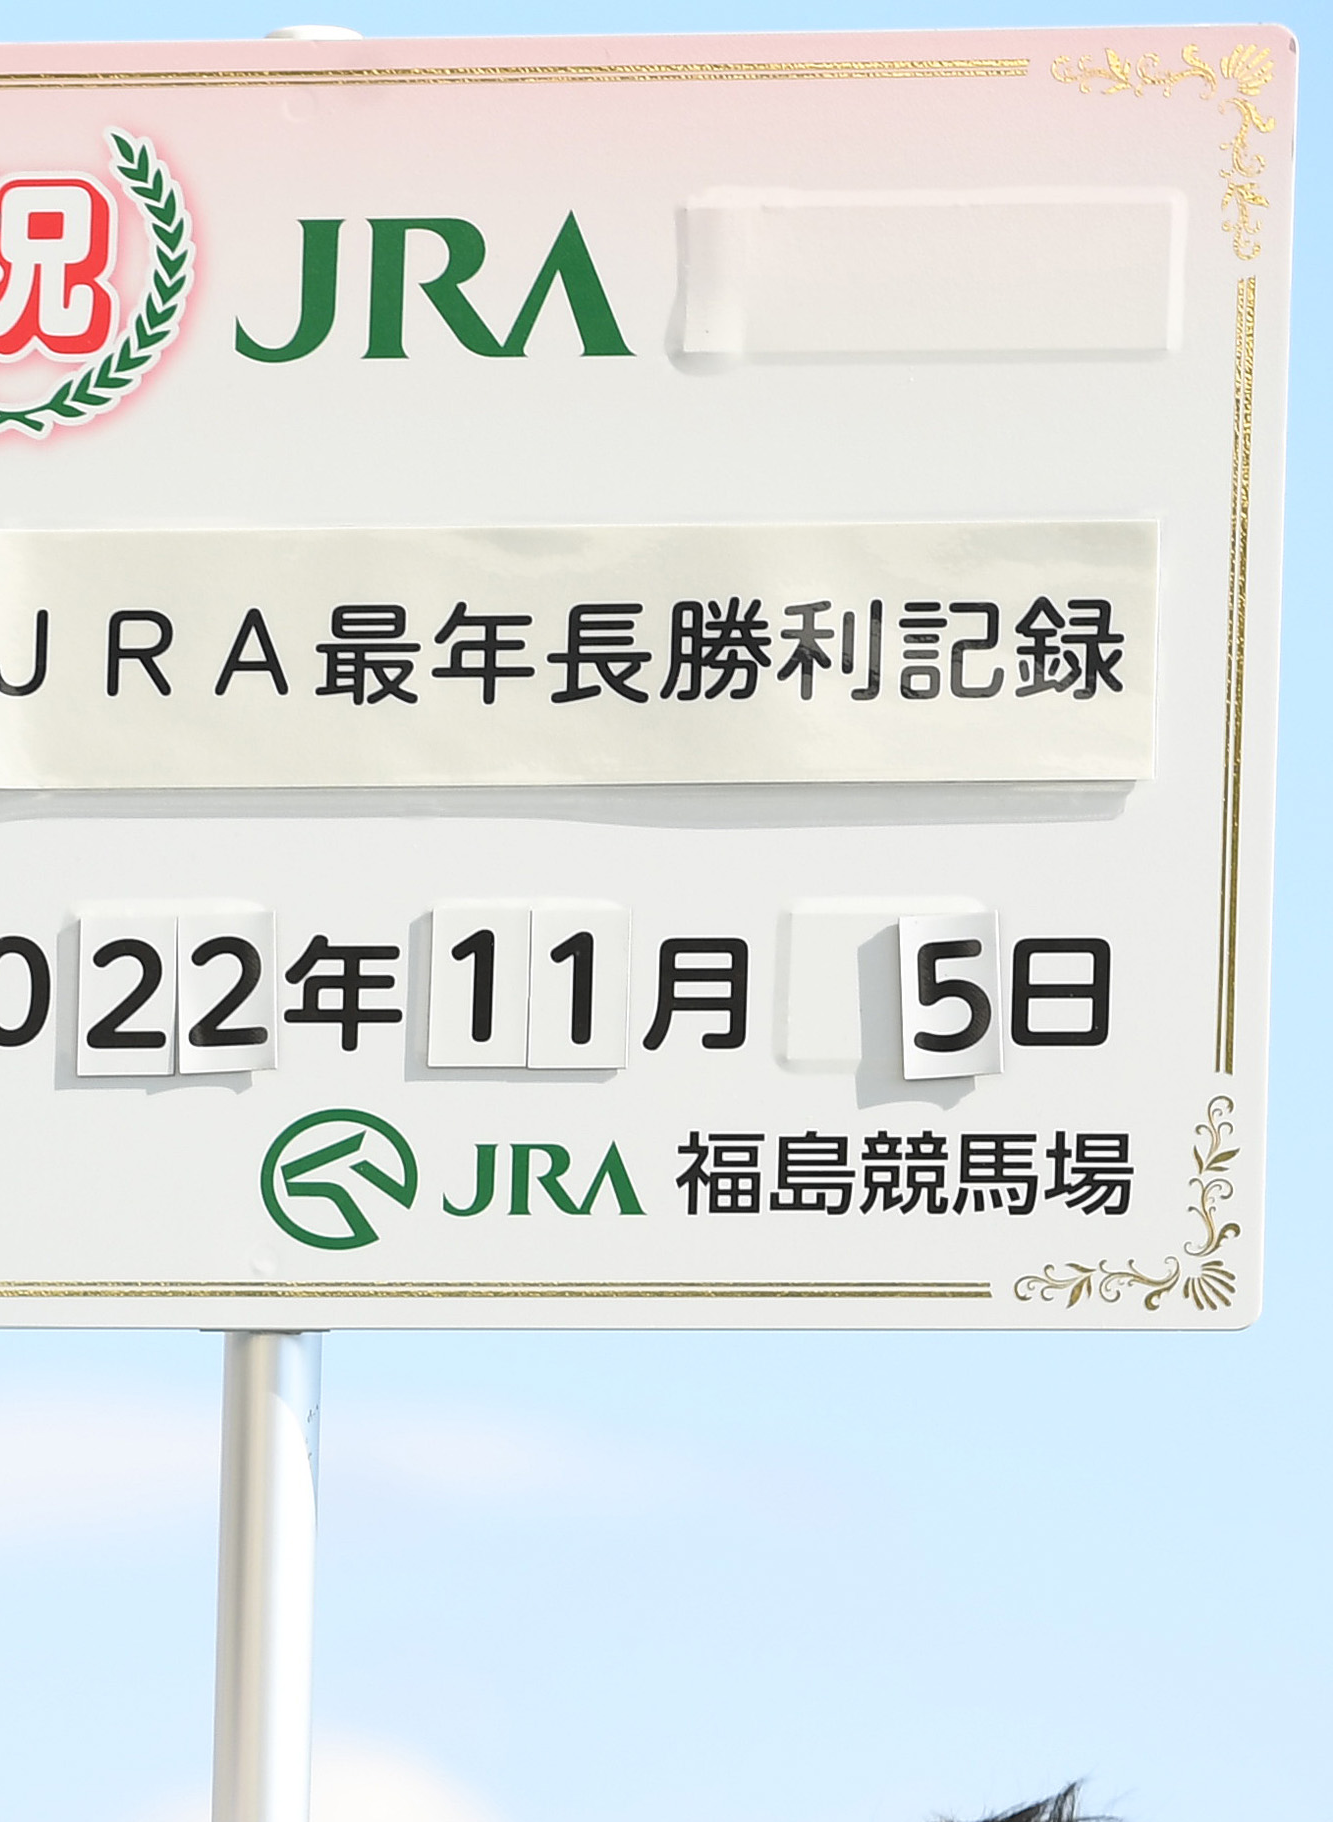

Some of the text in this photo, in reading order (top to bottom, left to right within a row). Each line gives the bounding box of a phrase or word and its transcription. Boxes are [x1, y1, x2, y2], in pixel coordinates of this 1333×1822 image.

[235, 210, 636, 363] JRA
[442, 1141, 646, 1217] JRA
[676, 1130, 1134, 1216] 福島競馬場
